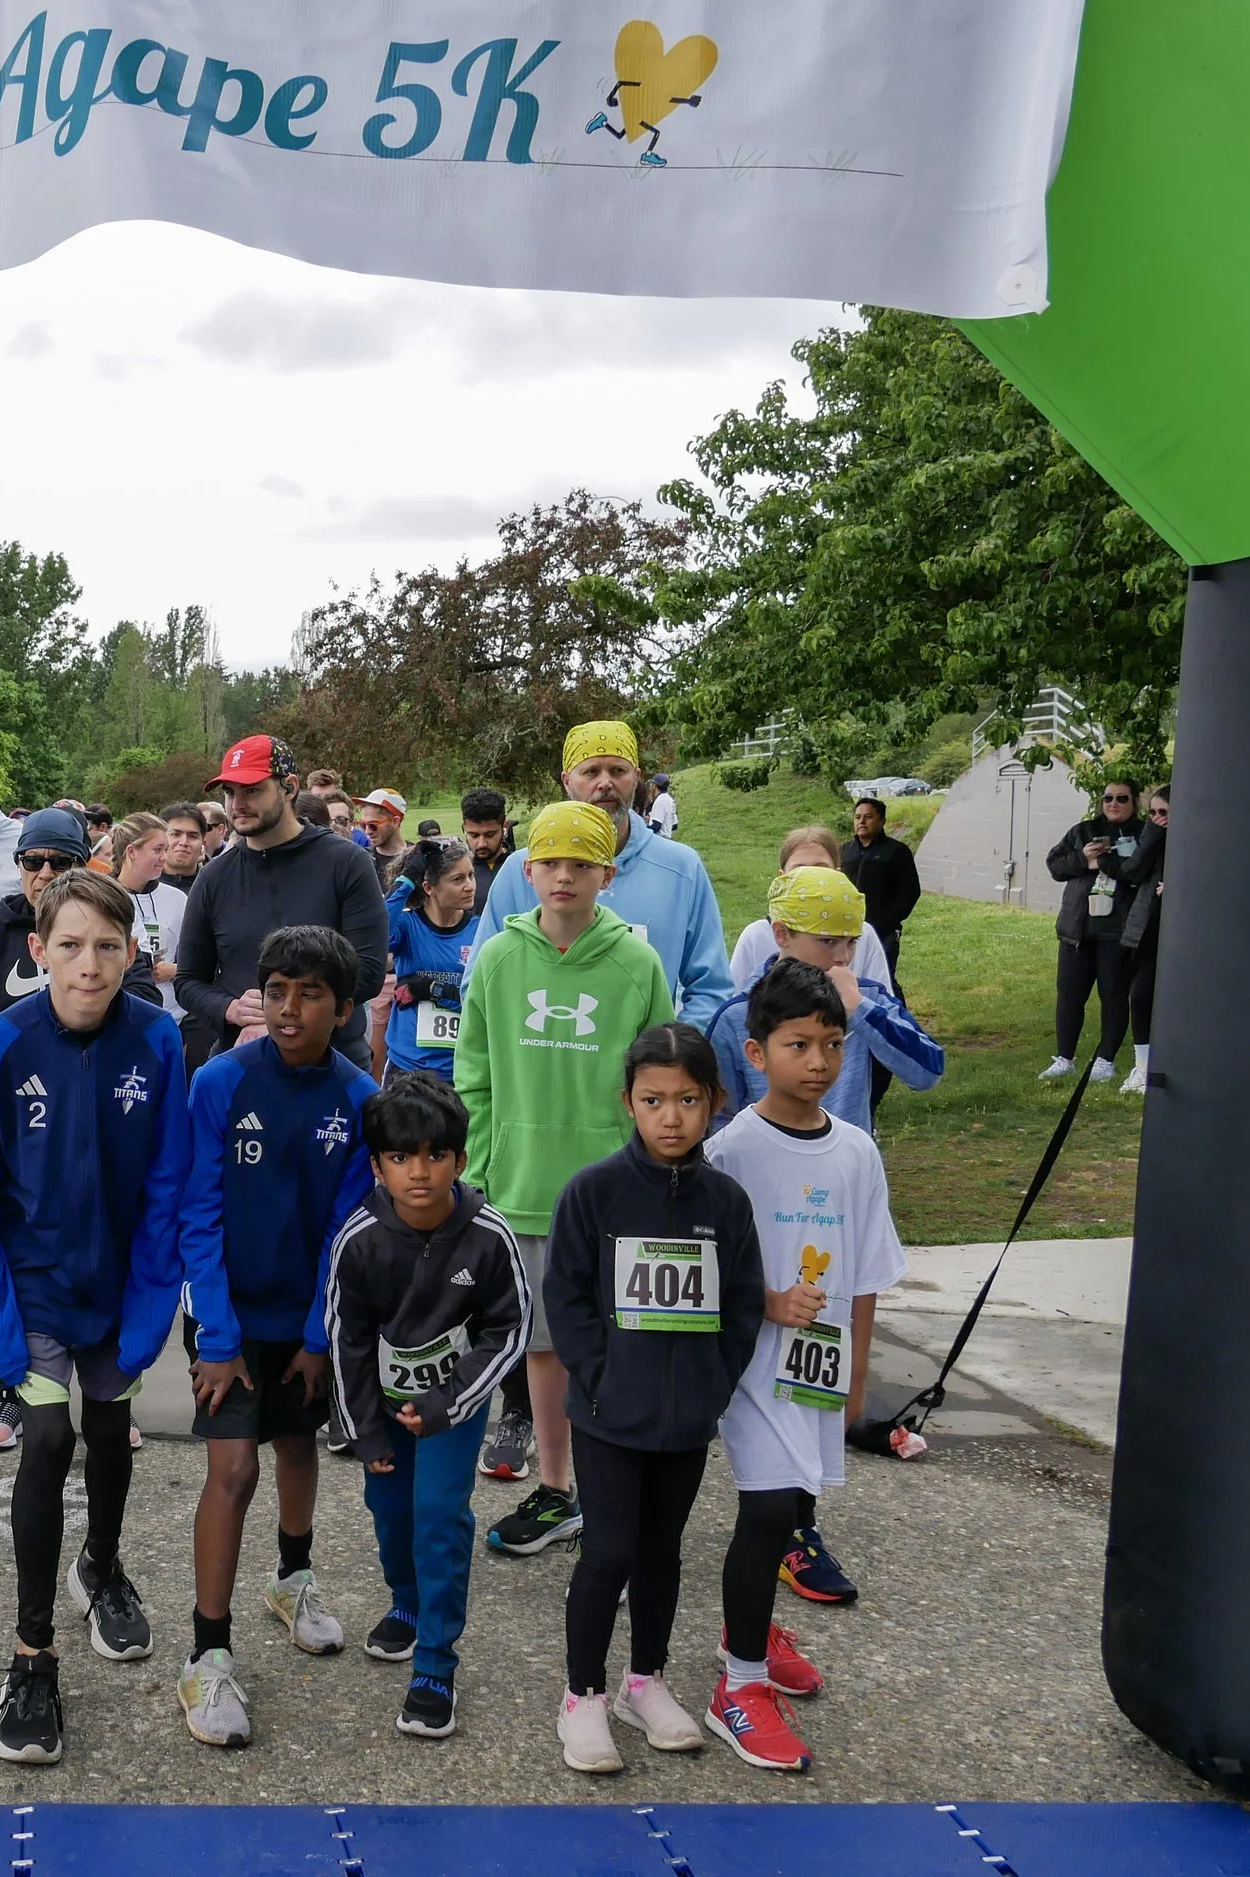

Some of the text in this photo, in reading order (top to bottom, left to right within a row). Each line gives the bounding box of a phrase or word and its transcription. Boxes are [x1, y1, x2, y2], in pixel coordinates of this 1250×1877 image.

[362, 38, 562, 164] 5K
[433, 1015, 460, 1038] 89
[519, 1038, 599, 1052] UNDER ARMOUR
[114, 1088, 147, 1101] TITANS
[29, 1102, 46, 1128] 2
[316, 1129, 348, 1143] TITANS
[235, 1139, 263, 1164] 19
[774, 1212, 794, 1222] Run
[795, 1212, 810, 1222] For
[811, 1213, 835, 1227] Agap
[648, 1243, 700, 1253] WOODINVILLE
[451, 1277, 475, 1286] adidas
[626, 1262, 704, 1308] 404
[389, 1351, 460, 1390] 299
[785, 1338, 841, 1388] 403
